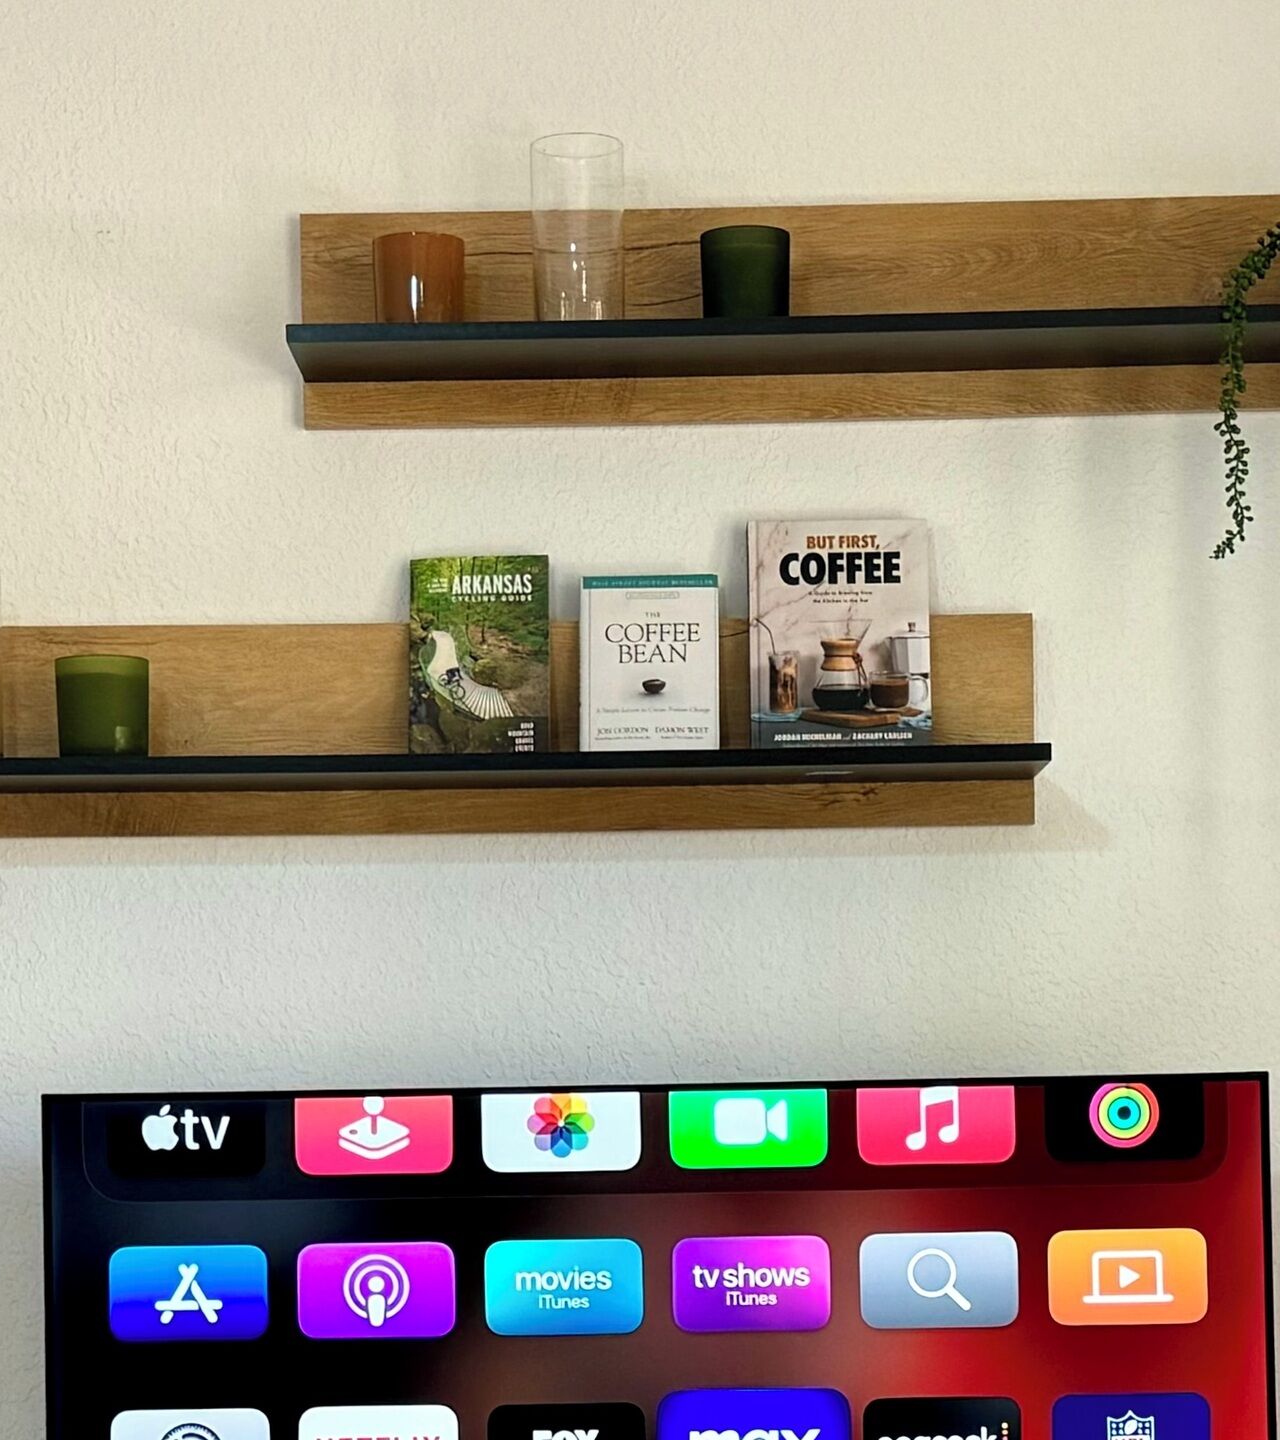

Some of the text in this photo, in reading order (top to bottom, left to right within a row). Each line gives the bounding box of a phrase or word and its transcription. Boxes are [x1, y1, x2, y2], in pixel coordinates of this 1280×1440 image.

[806, 535, 880, 550] BUT FIRST,
[780, 551, 901, 585] COFFEE
[452, 574, 532, 595] ARKANSAS
[605, 623, 701, 643] COFFEE
[618, 643, 687, 664] BEAN
[179, 1109, 231, 1151] tv
[516, 1265, 612, 1292] movies
[693, 1262, 811, 1288] tv shows
